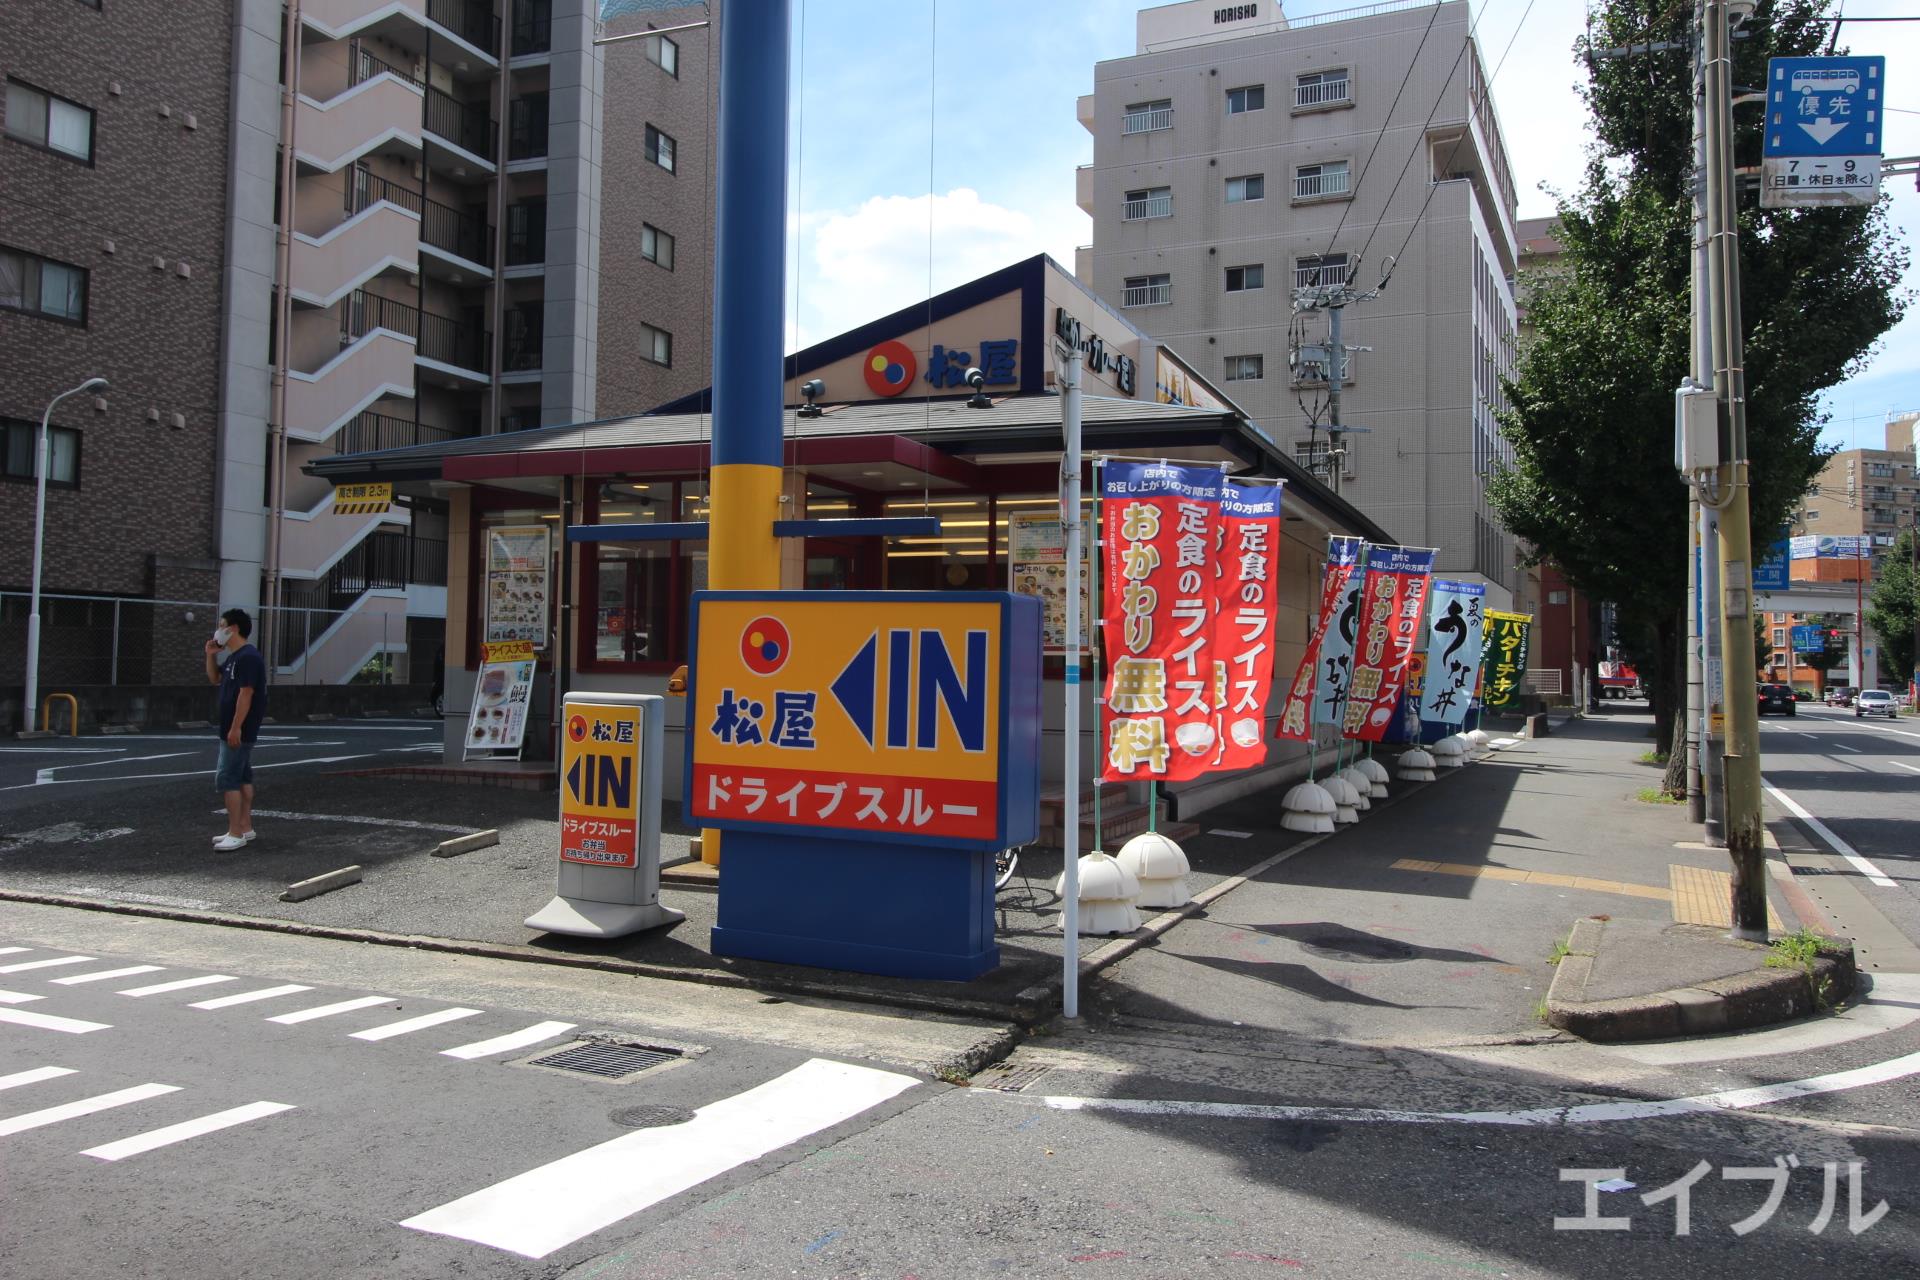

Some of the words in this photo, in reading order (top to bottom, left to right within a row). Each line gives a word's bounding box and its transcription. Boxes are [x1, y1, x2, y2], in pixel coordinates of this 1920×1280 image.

[1214, 3, 1257, 24] HORISHO
[1798, 96, 1851, 115] 優先
[924, 338, 1018, 387] 松屋
[1107, 479, 1217, 498] お召し上がりの方限定
[1144, 468, 1178, 479] 店内で
[1172, 502, 1213, 717] 定食のライス
[1233, 522, 1268, 714] 定食のライス
[1467, 597, 1482, 627] 夏の
[1378, 577, 1425, 704] 定食のライス
[1492, 621, 1523, 706] バターチキン
[887, 628, 989, 753] IN
[592, 719, 634, 743] 松屋
[710, 687, 817, 751] 松屋
[584, 753, 631, 809] IN
[707, 773, 979, 827] ドライブスルー
[563, 817, 632, 837] ドライブスルー
[582, 838, 606, 850] お弁当
[565, 848, 627, 863] お持ち帰り出来ます
